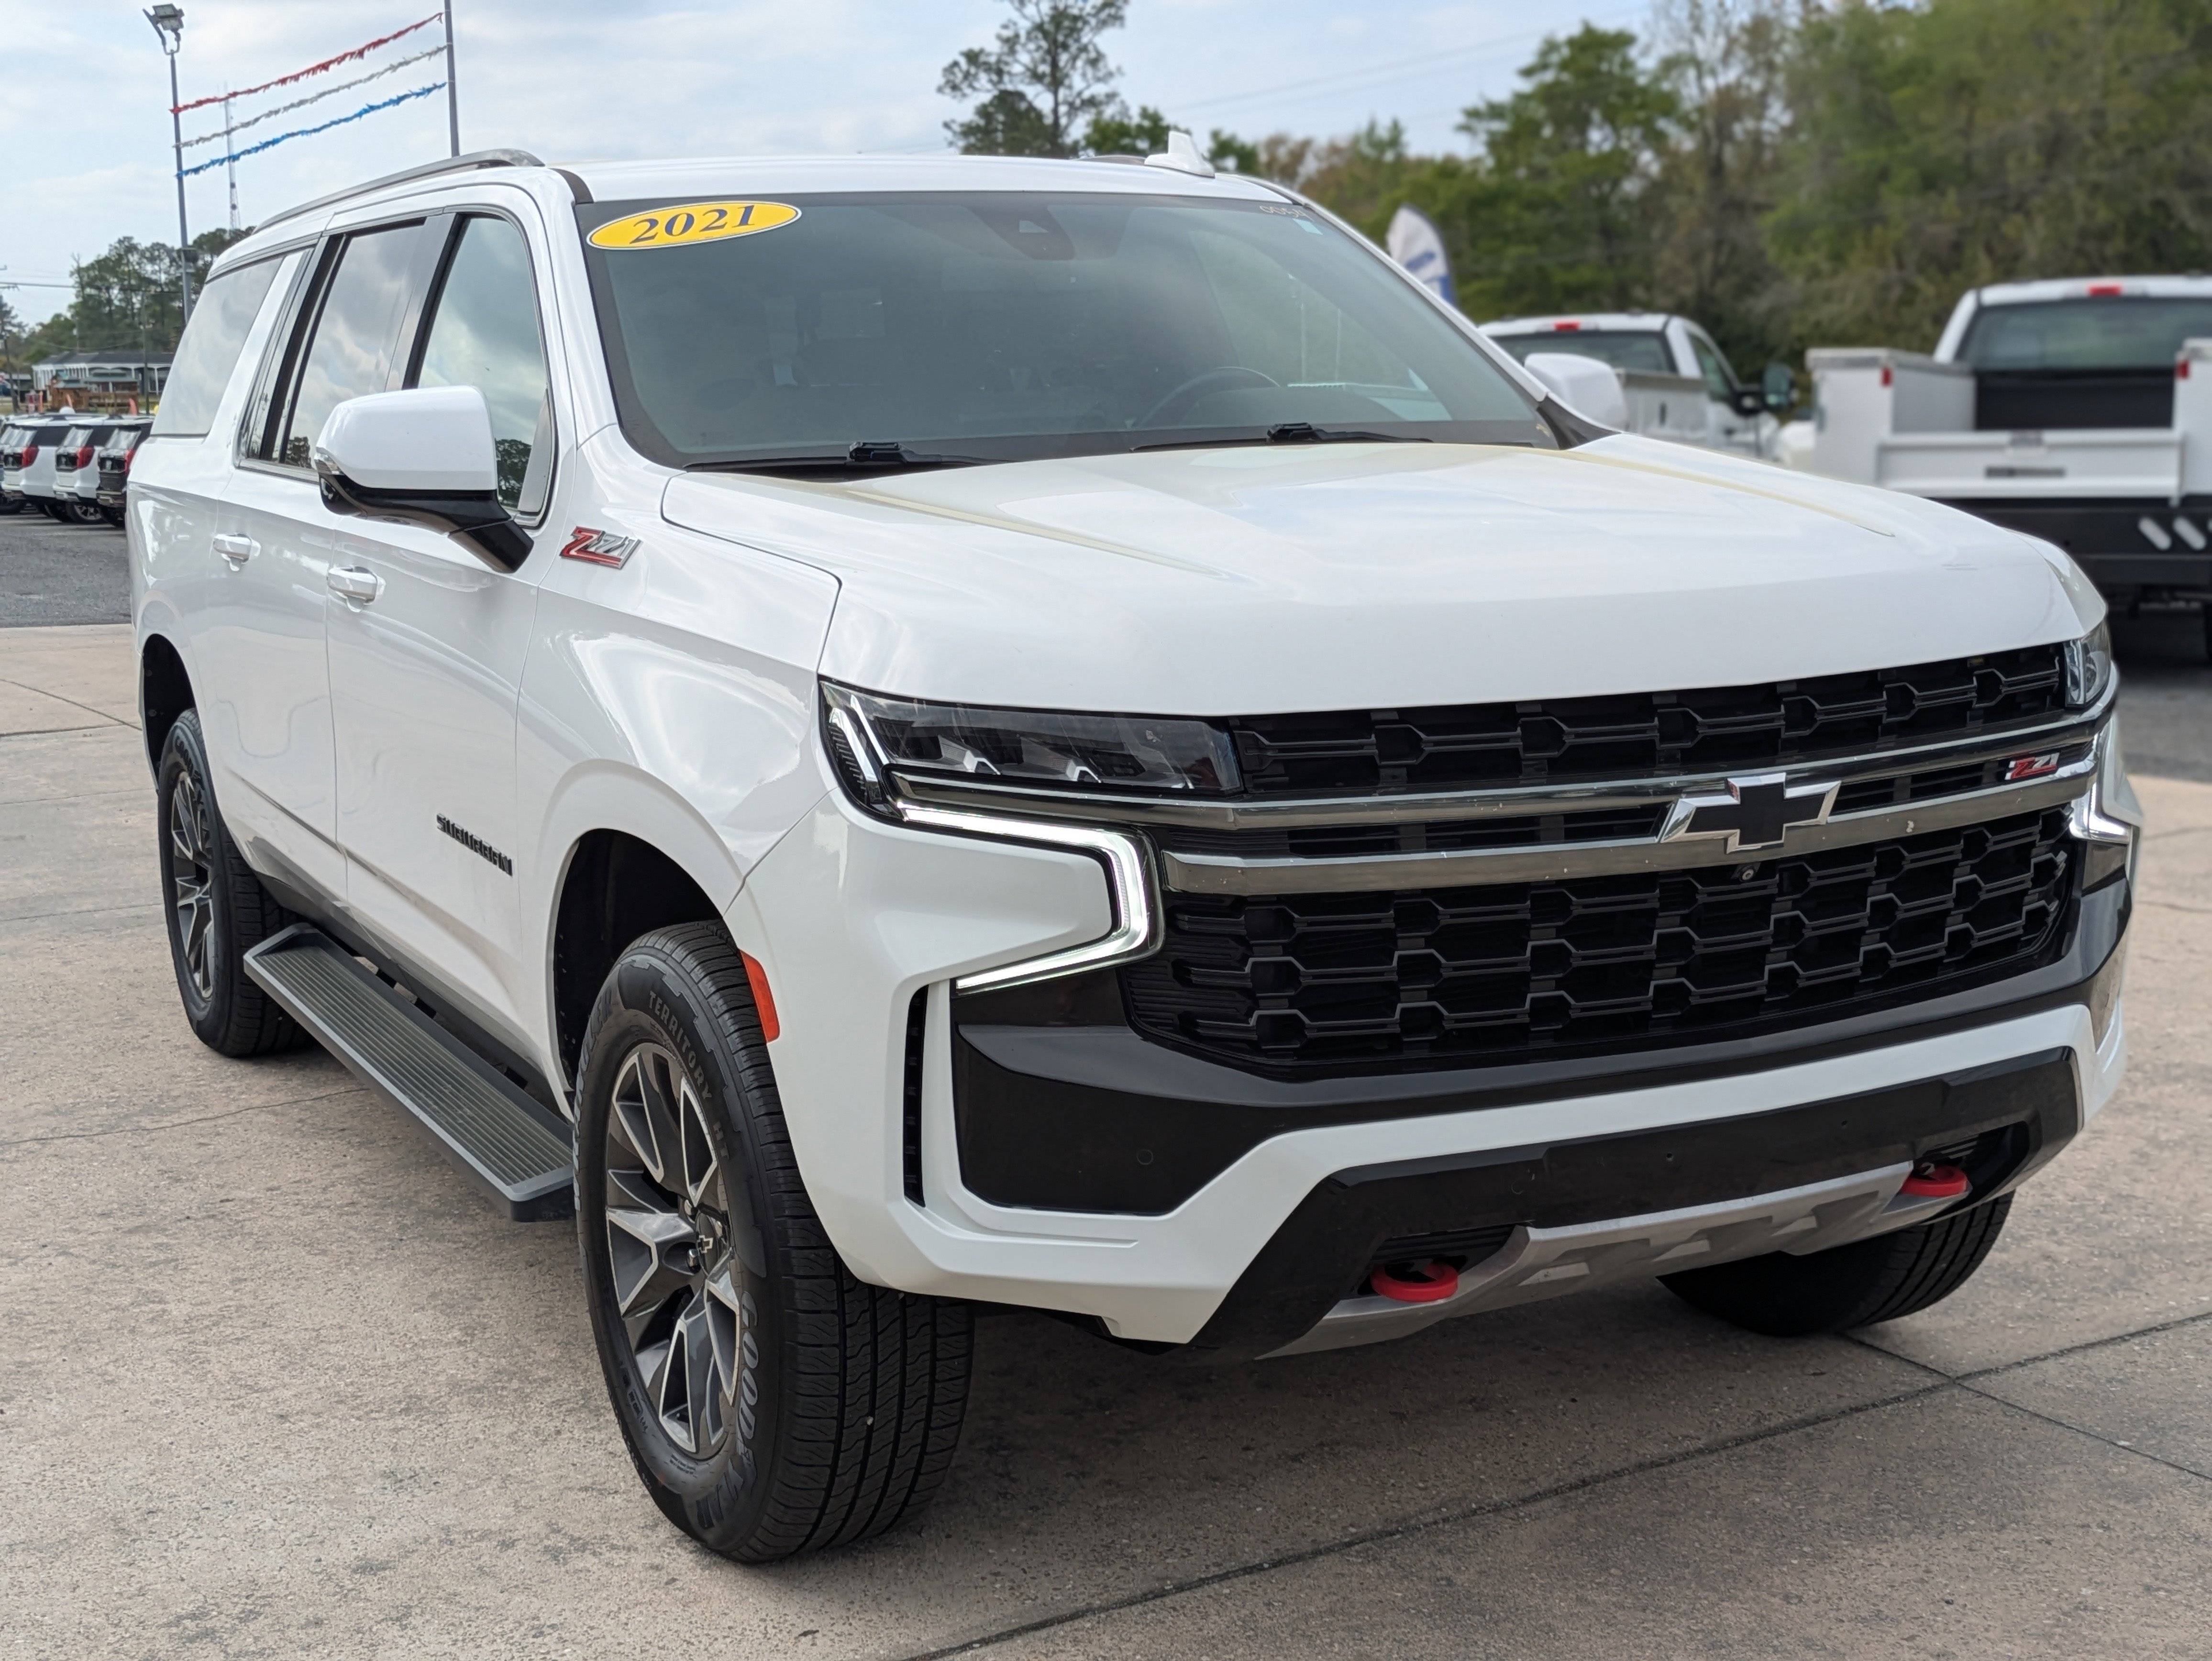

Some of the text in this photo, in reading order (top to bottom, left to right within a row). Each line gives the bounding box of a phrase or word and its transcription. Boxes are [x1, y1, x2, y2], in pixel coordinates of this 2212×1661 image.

[629, 204, 755, 244] 2021
[559, 526, 643, 570] Z71
[2010, 752, 2060, 779] Z71
[436, 813, 513, 877] SUBURBAN
[649, 990, 712, 1099] TERRITORY
[696, 1291, 759, 1529] GOODYEAR
